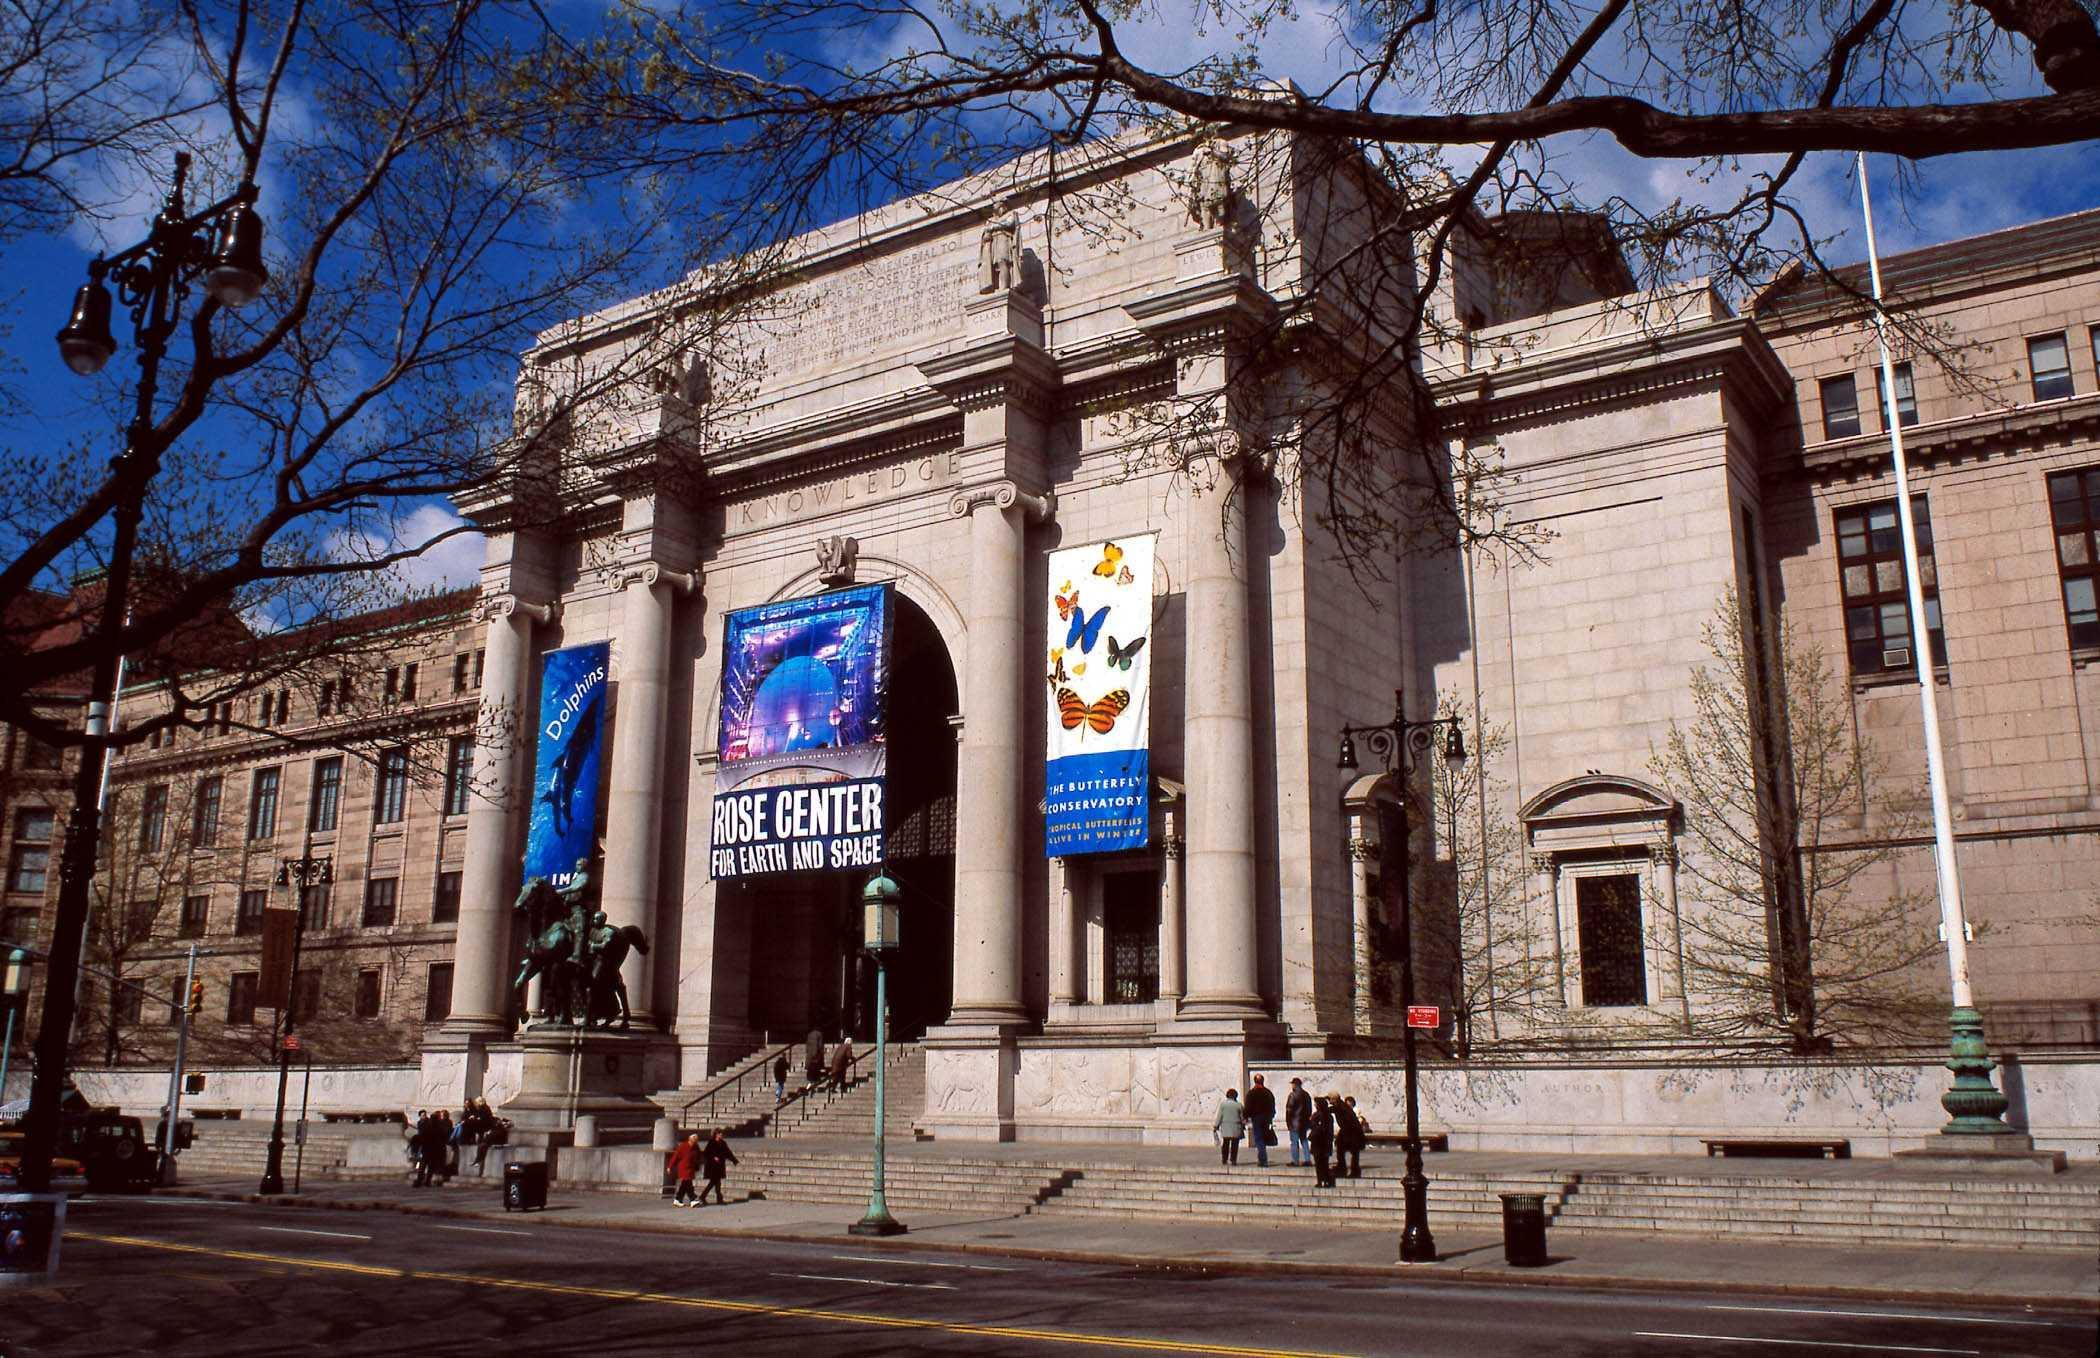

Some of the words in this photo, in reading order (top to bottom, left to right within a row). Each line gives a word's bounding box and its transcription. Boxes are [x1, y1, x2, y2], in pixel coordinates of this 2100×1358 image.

[858, 261, 930, 294] ROOSEVELT
[741, 453, 961, 525] KNOWLEDGE
[545, 665, 604, 741] Dolphins
[1049, 783, 1064, 796] THE
[1069, 776, 1143, 792] BUTTERFLY
[713, 793, 768, 846] ROSE
[776, 783, 882, 839] CENTER
[1048, 796, 1143, 814] CONSERVATORY
[1078, 833, 1090, 841] IN
[1096, 828, 1142, 840] WINTER
[1085, 817, 1143, 829] BUTTERFLIES
[712, 849, 736, 877] FOR
[740, 843, 787, 875] EARTH
[793, 840, 824, 870] AND
[831, 834, 882, 868] SPACE
